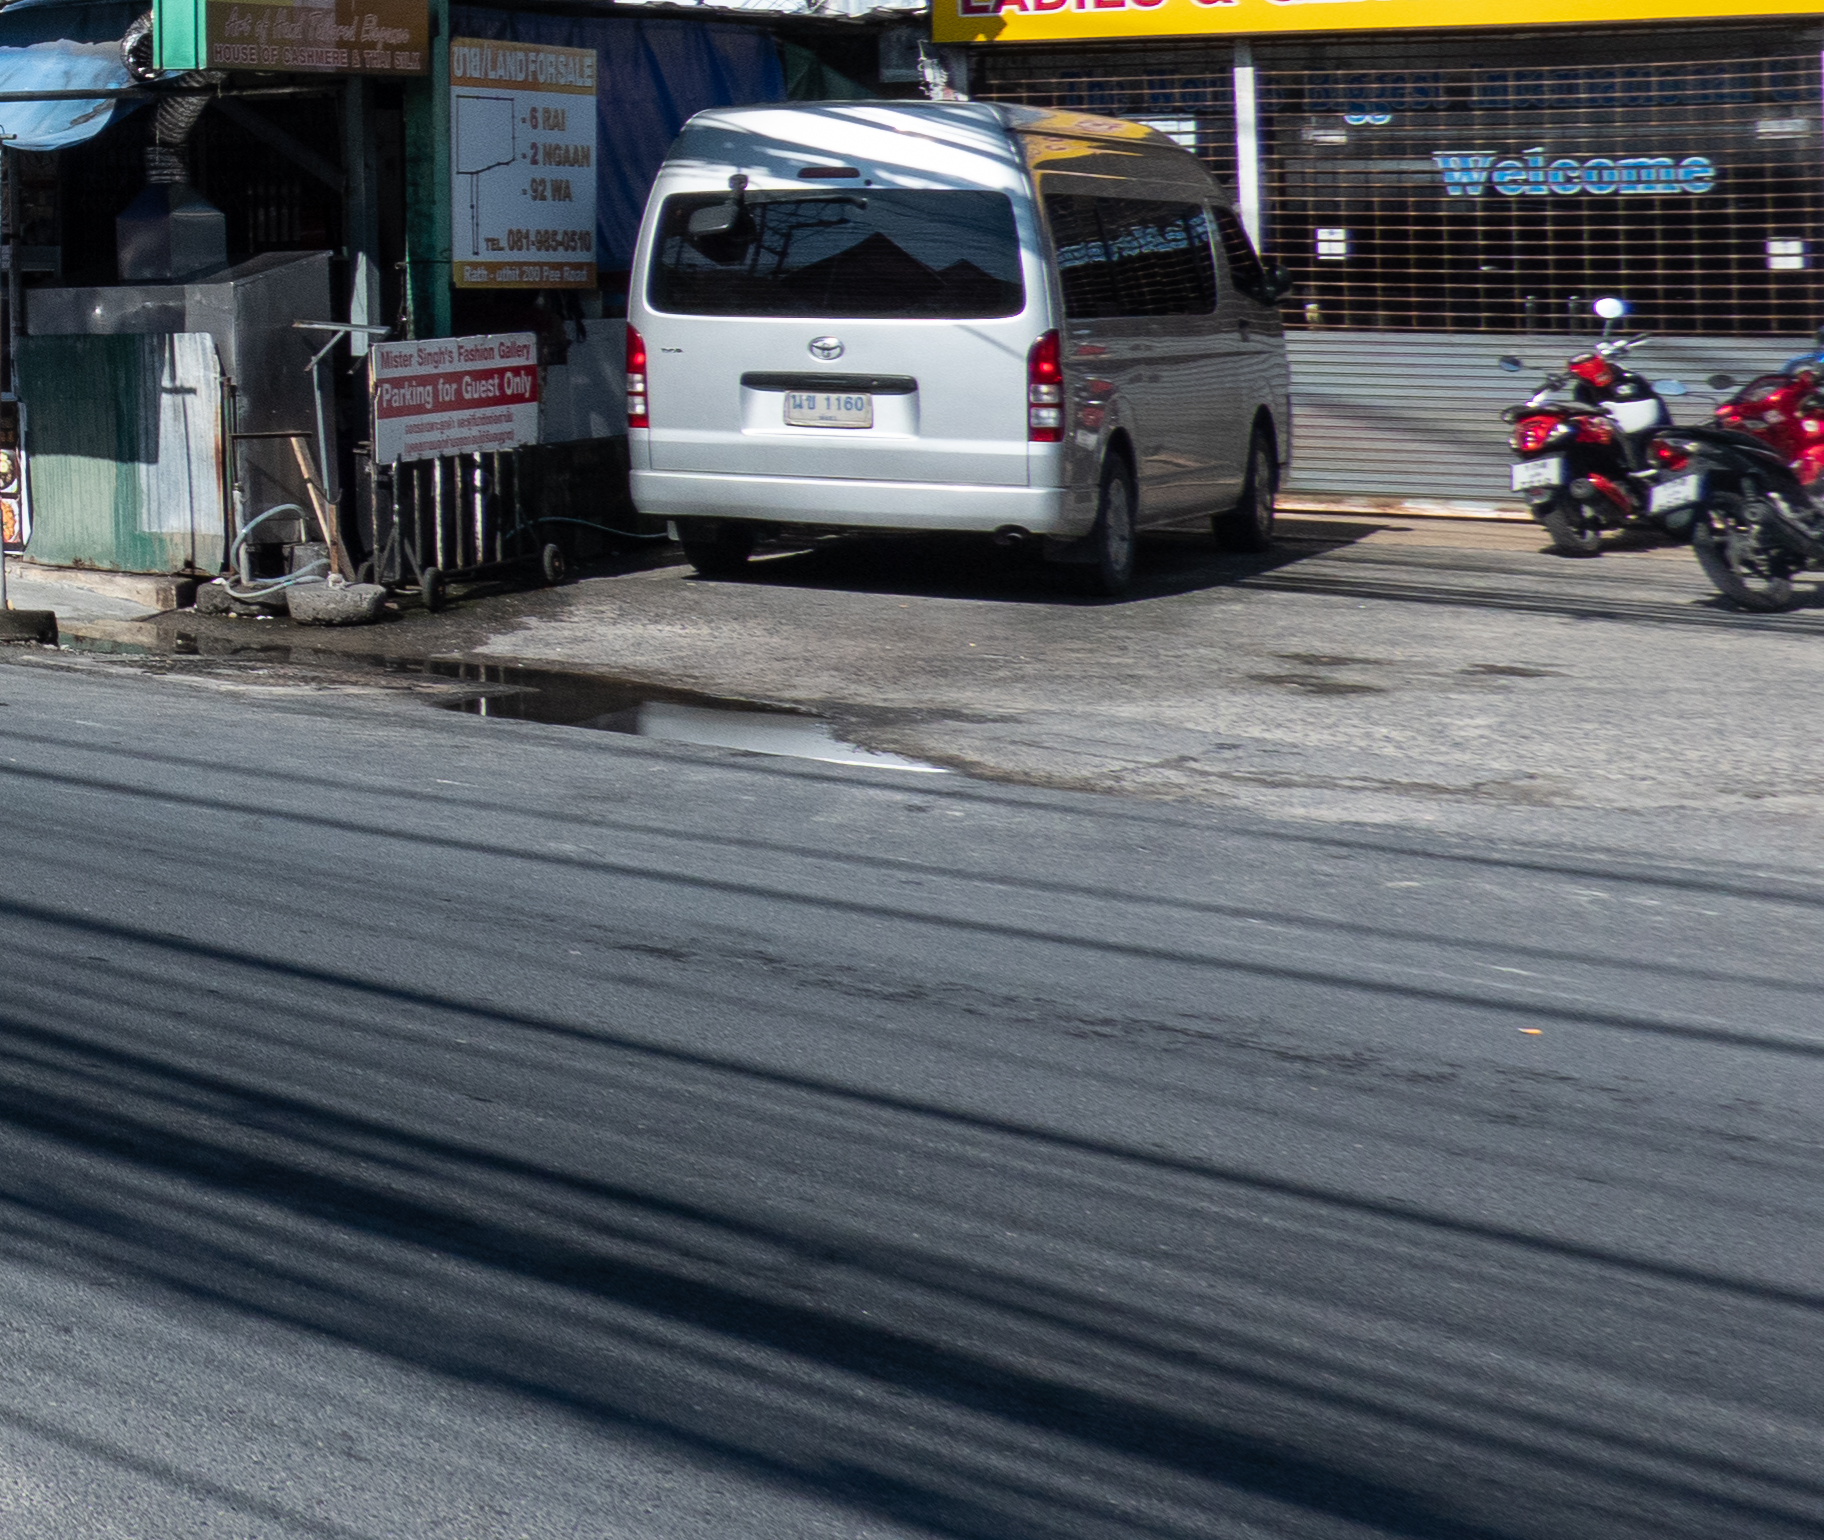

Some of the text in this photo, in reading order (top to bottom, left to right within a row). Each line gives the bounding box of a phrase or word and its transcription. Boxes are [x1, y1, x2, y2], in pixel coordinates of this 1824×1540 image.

[214, 44, 256, 64] HOUSE
[260, 45, 279, 65] OF
[284, 46, 348, 67] CASHMERE
[363, 49, 391, 69] THAI
[528, 51, 556, 83] FOR
[557, 55, 594, 86] SALE
[542, 107, 566, 131] RAI
[530, 142, 591, 167] 2 NGAAN
[1432, 147, 1716, 195] Welcome
[530, 178, 573, 202] 92 WA
[380, 341, 531, 369] Mister Singh's Fashion Gallery
[382, 370, 532, 409] Parking for Guest Only
[825, 395, 864, 411] 1160
